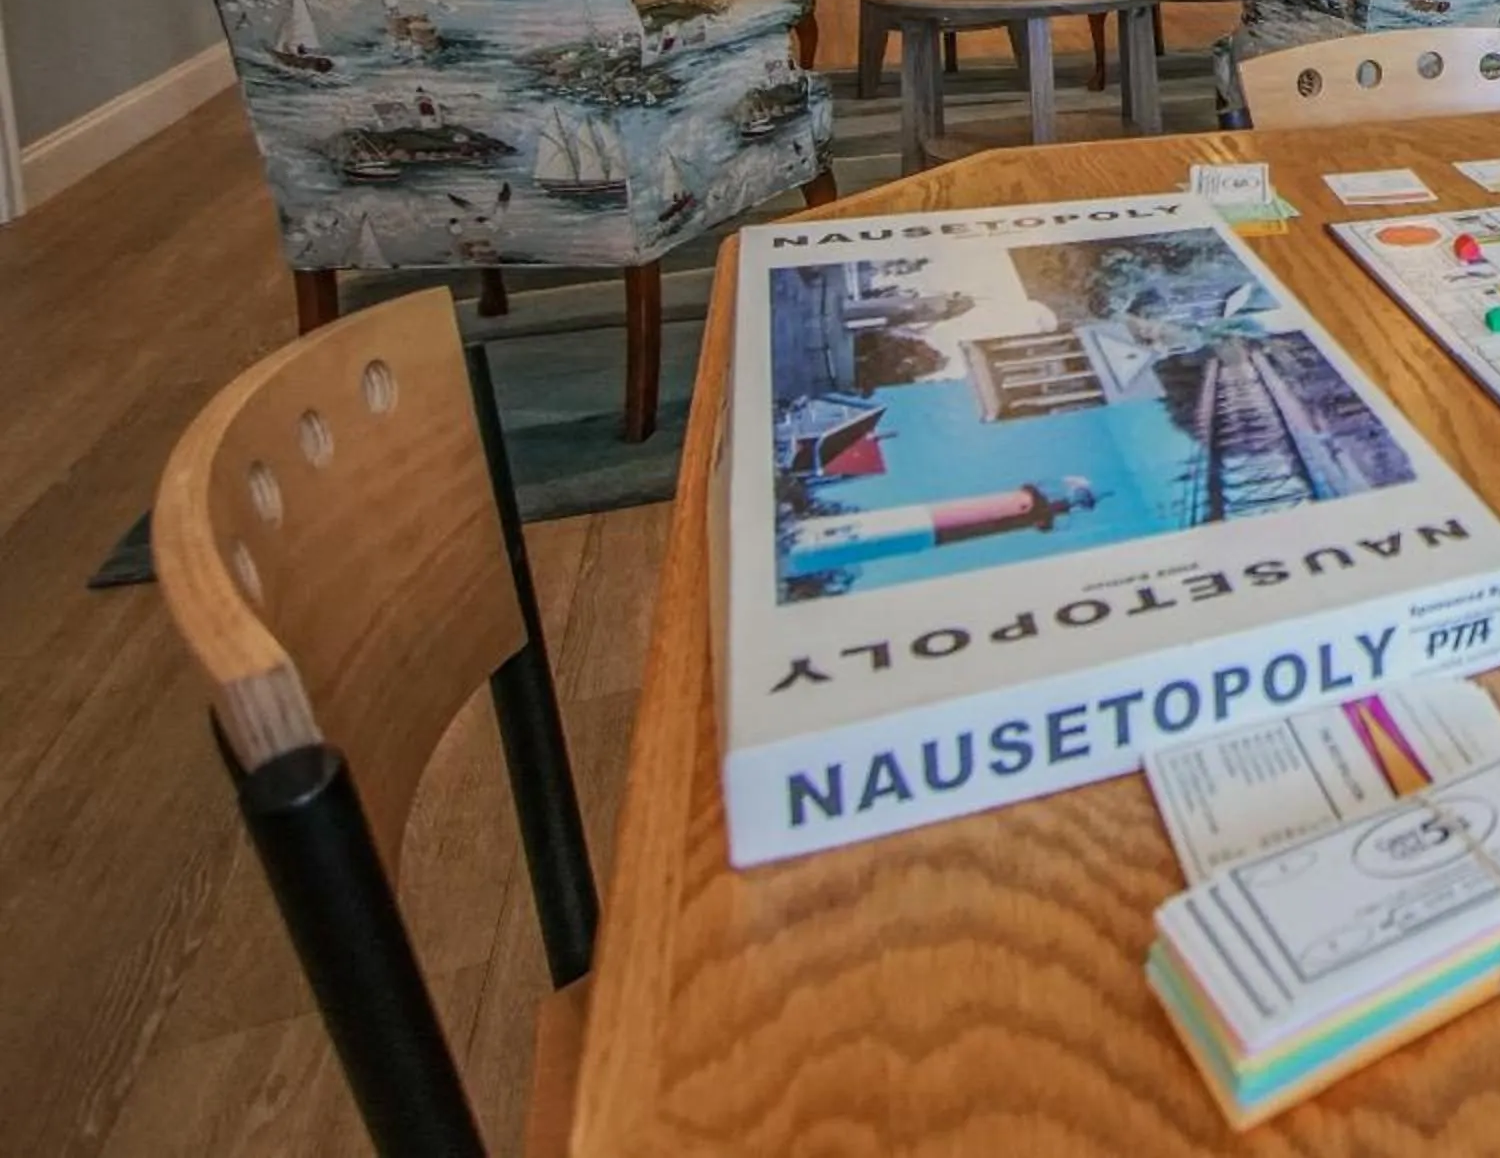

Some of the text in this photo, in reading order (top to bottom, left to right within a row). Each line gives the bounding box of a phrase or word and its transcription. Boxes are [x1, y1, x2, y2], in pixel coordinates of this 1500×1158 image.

[773, 204, 1182, 248] NAUSETOPOLY
[769, 518, 1471, 694] NAUSETOPOLY
[1426, 618, 1490, 660] PTA
[788, 626, 1400, 828] NAUSETOPOLY
